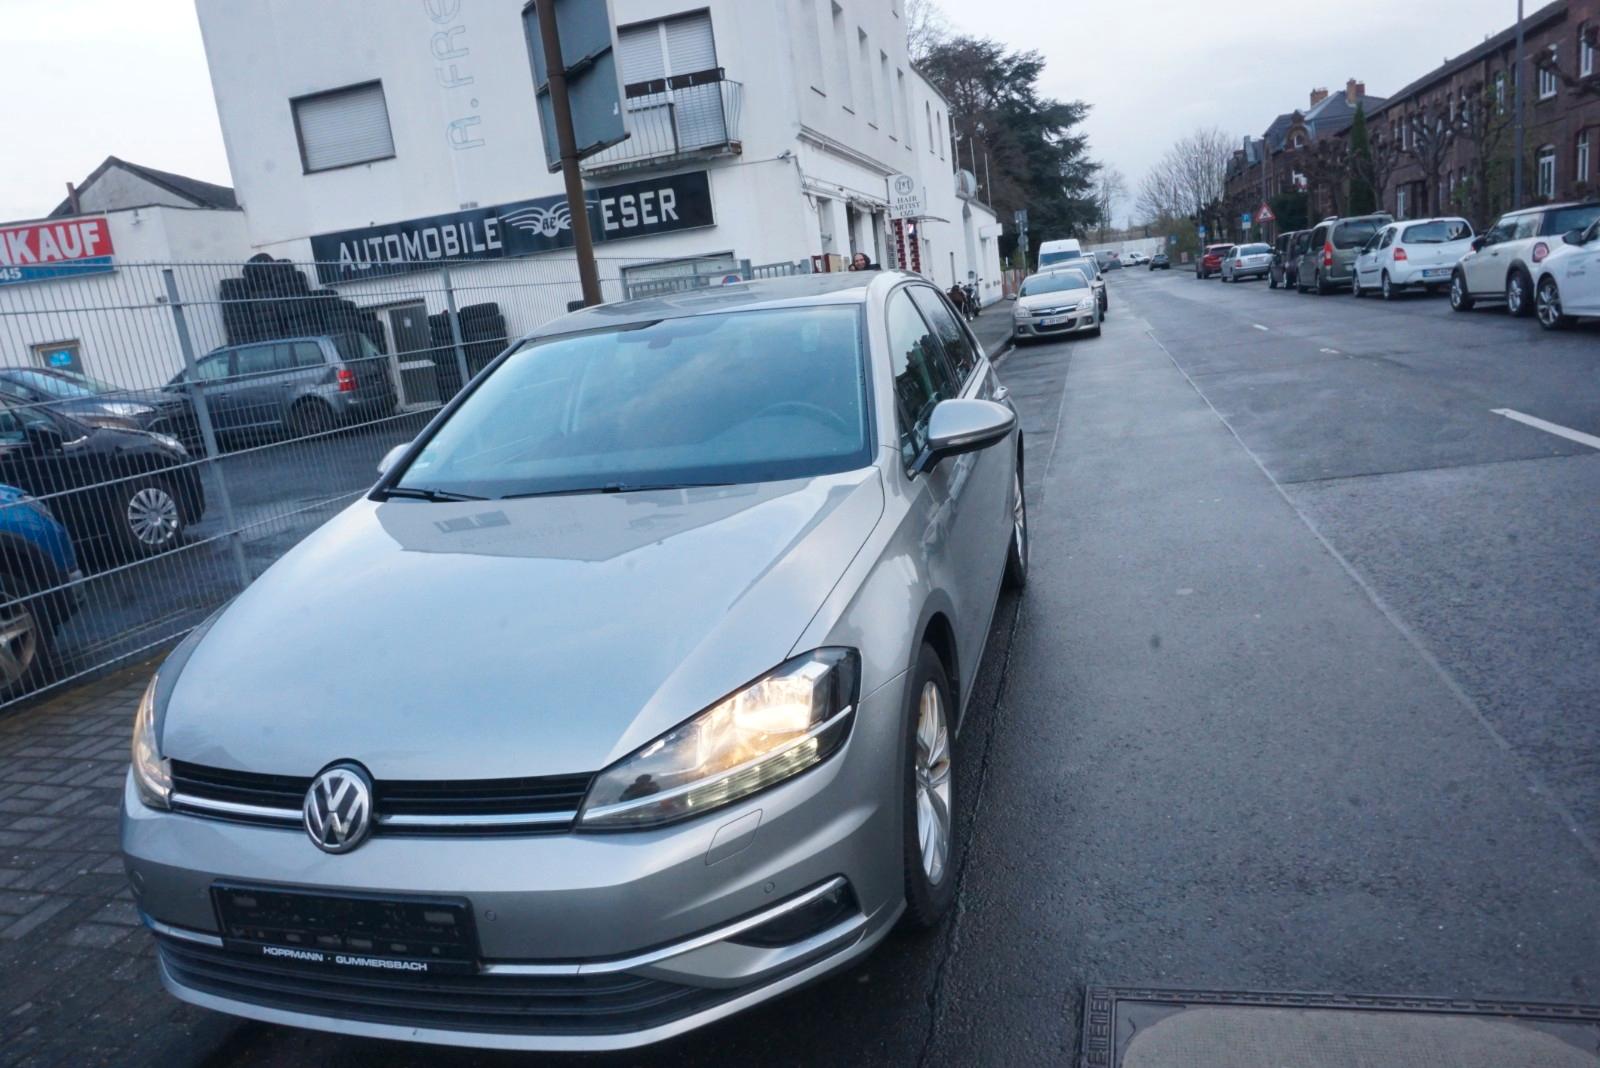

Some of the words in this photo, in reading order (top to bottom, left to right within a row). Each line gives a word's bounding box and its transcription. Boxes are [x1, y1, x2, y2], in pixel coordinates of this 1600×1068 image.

[338, 216, 503, 273] AUTOMOBILE
[601, 187, 680, 232] ESER
[304, 768, 369, 849] VW
[262, 946, 324, 962] HOPPMANN
[335, 955, 428, 971] GUMMERSBACH
